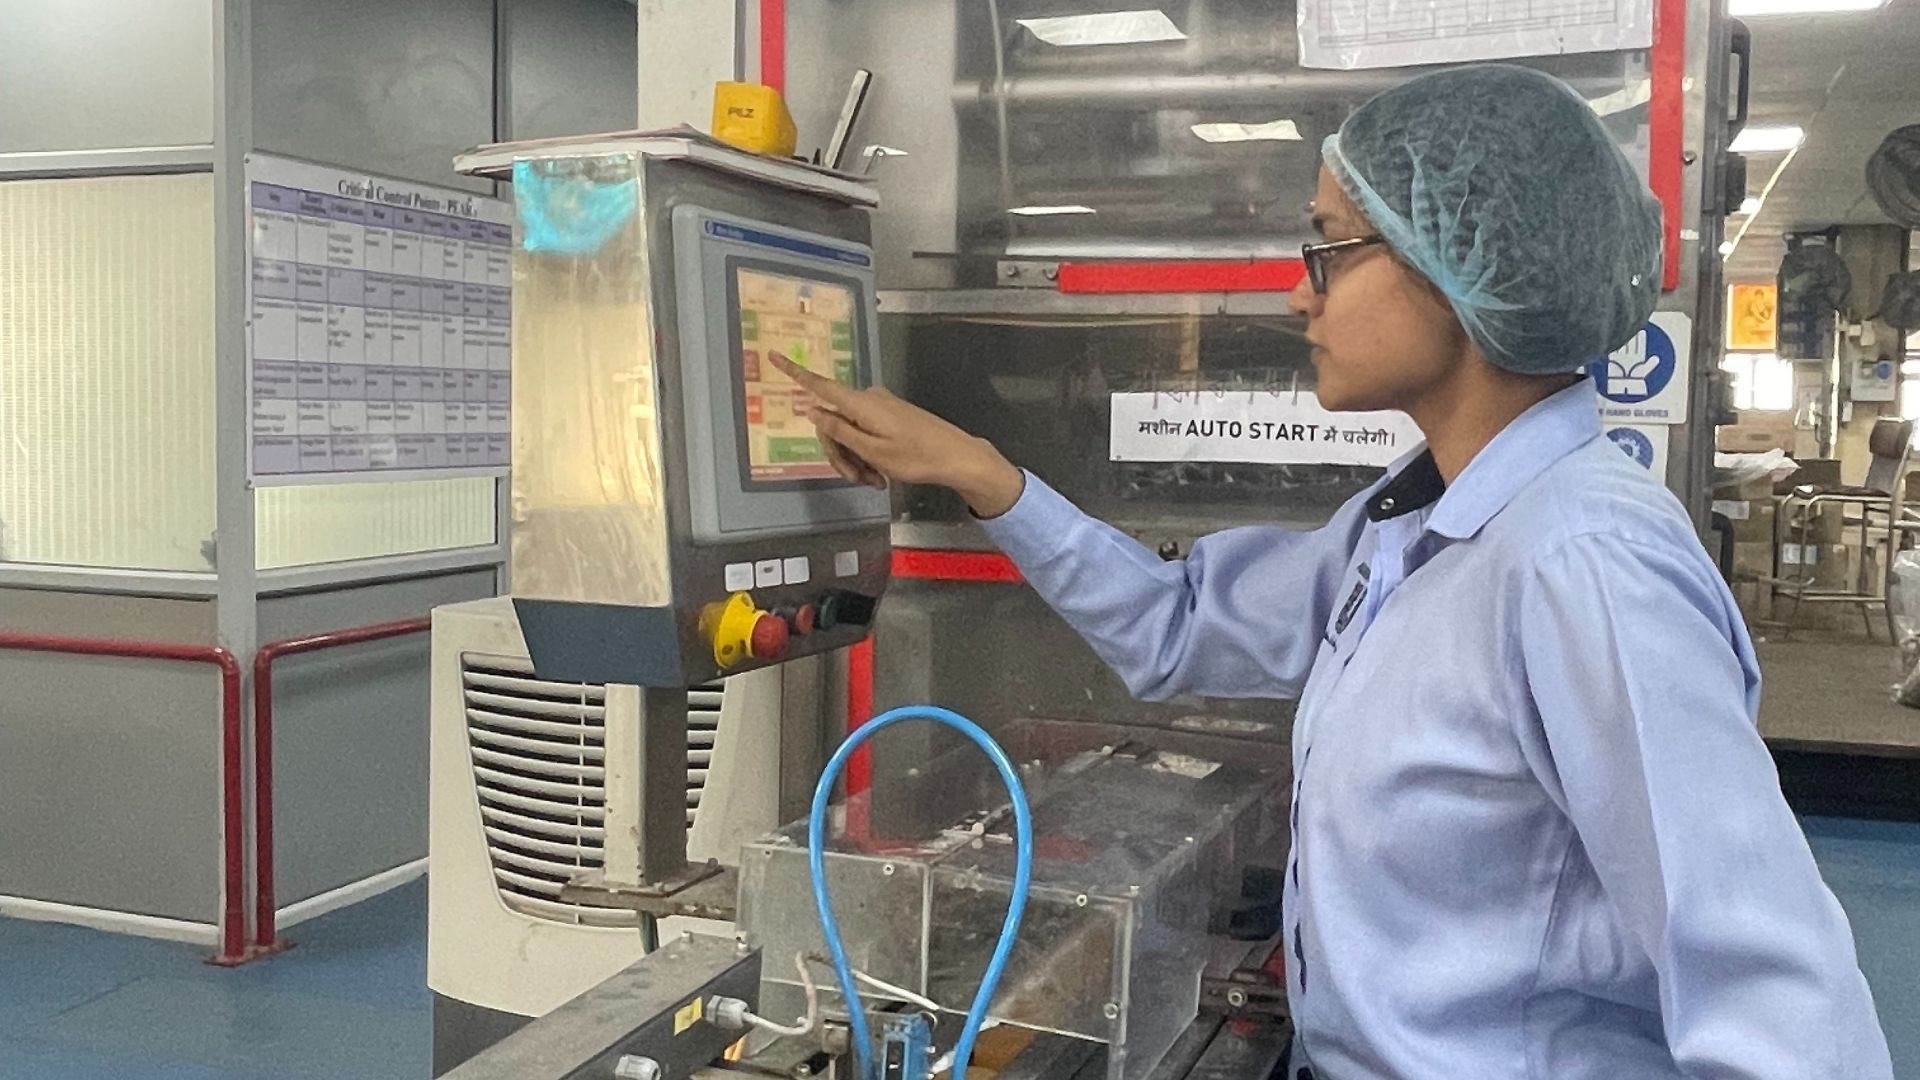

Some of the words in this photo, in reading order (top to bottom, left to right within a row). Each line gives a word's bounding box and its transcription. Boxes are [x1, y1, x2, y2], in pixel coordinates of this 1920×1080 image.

[728, 106, 754, 118] PILZ
[376, 186, 412, 206] Control
[1634, 409, 1668, 417] GLOVES
[1138, 418, 1182, 436] मशीन
[1185, 419, 1242, 438] AUTO
[1249, 422, 1319, 442] START
